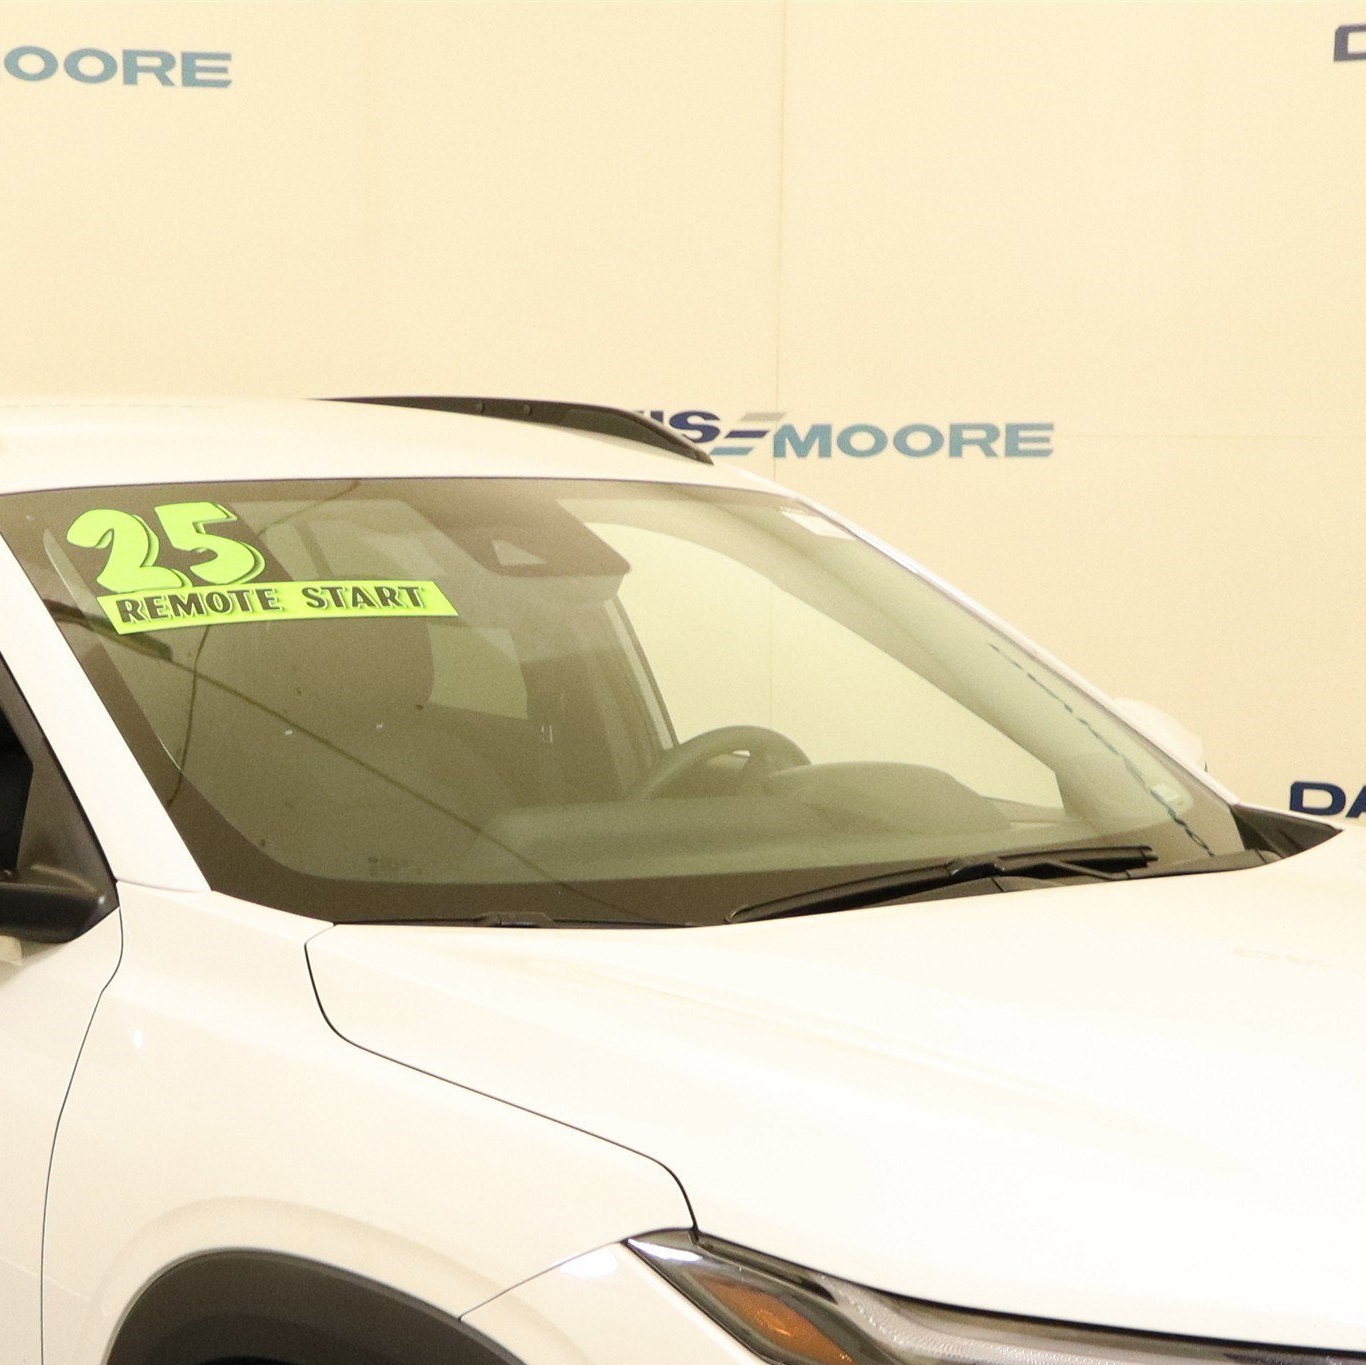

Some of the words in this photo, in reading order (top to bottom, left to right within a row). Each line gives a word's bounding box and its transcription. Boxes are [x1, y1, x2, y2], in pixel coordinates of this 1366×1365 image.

[773, 424, 1053, 459] MOORE
[66, 501, 266, 593] 25
[116, 587, 286, 624] REMOTE
[302, 584, 426, 611] START
